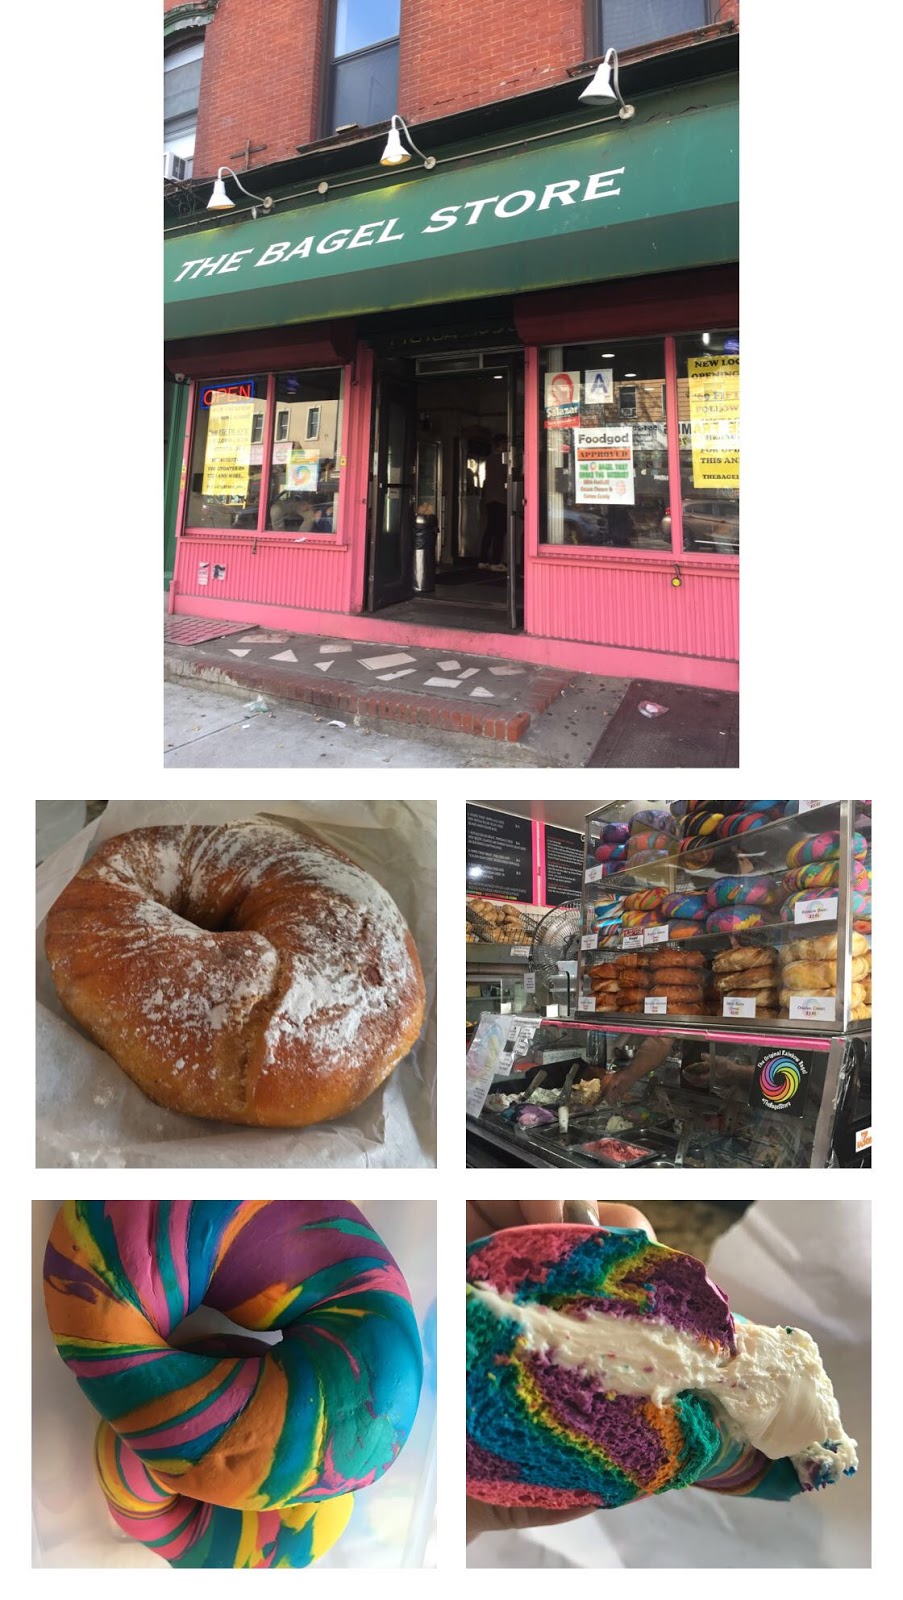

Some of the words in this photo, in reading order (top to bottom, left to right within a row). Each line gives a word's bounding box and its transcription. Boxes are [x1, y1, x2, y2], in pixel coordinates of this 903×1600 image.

[173, 247, 253, 283] THE
[254, 217, 405, 268] BAGEL
[420, 166, 626, 234] STORE
[694, 360, 719, 368] NEW
[691, 371, 739, 379] OPENING
[590, 373, 608, 394] A
[203, 384, 251, 406] OPEN
[578, 432, 629, 445] Foodgod
[580, 450, 628, 458] APPROVED
[763, 1050, 782, 1062] Original
[781, 1050, 800, 1063] Rainbow
